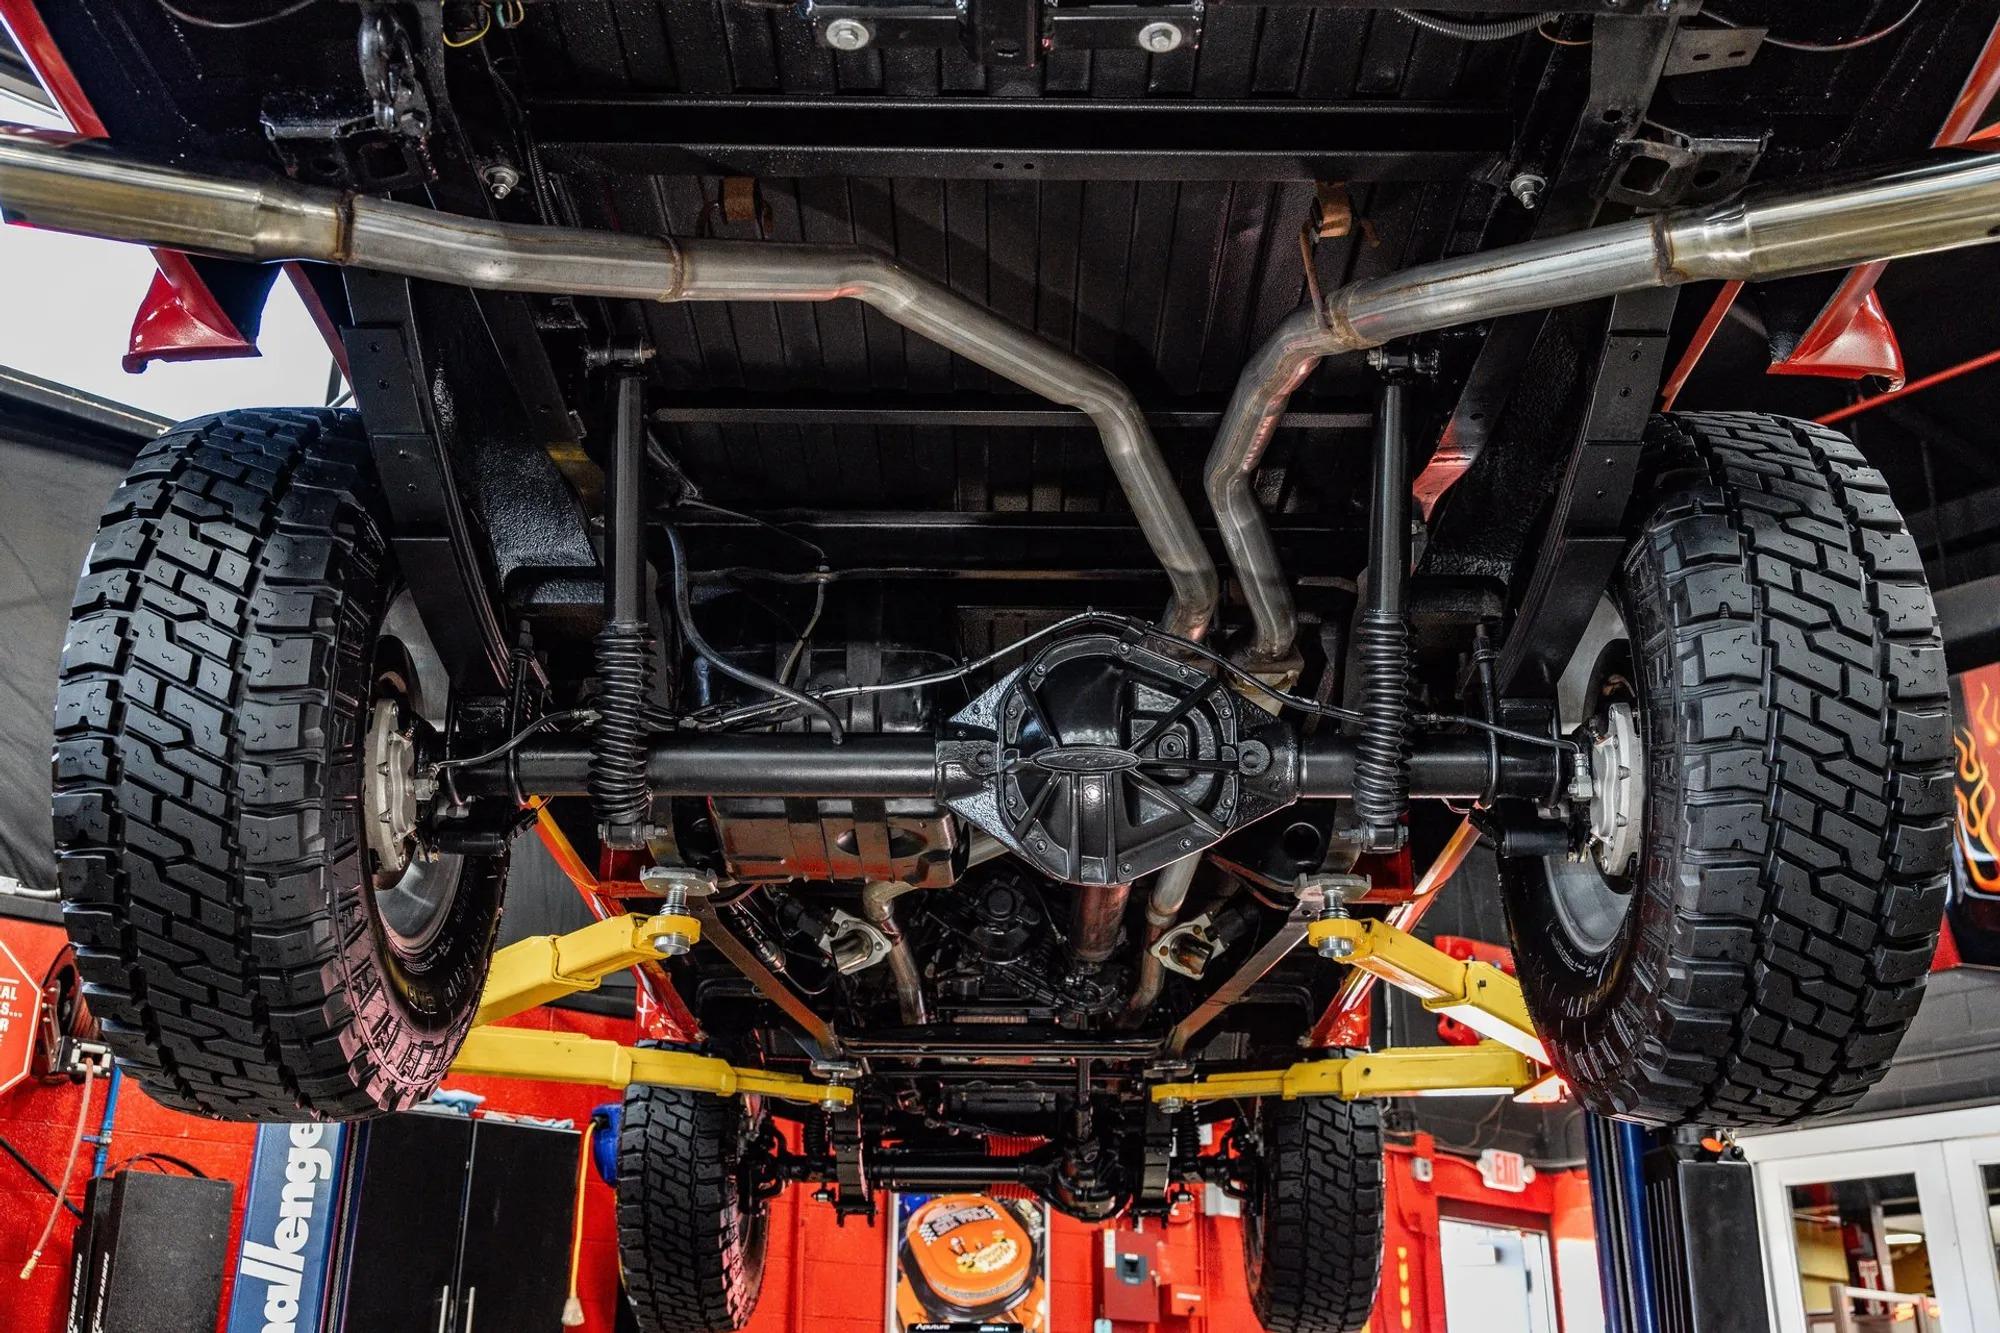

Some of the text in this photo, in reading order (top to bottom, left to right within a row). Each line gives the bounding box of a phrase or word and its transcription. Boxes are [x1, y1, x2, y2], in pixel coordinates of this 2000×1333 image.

[0, 985, 17, 1000] AL
[0, 1001, 23, 1018] S...
[1495, 1152, 1519, 1185] EXIT
